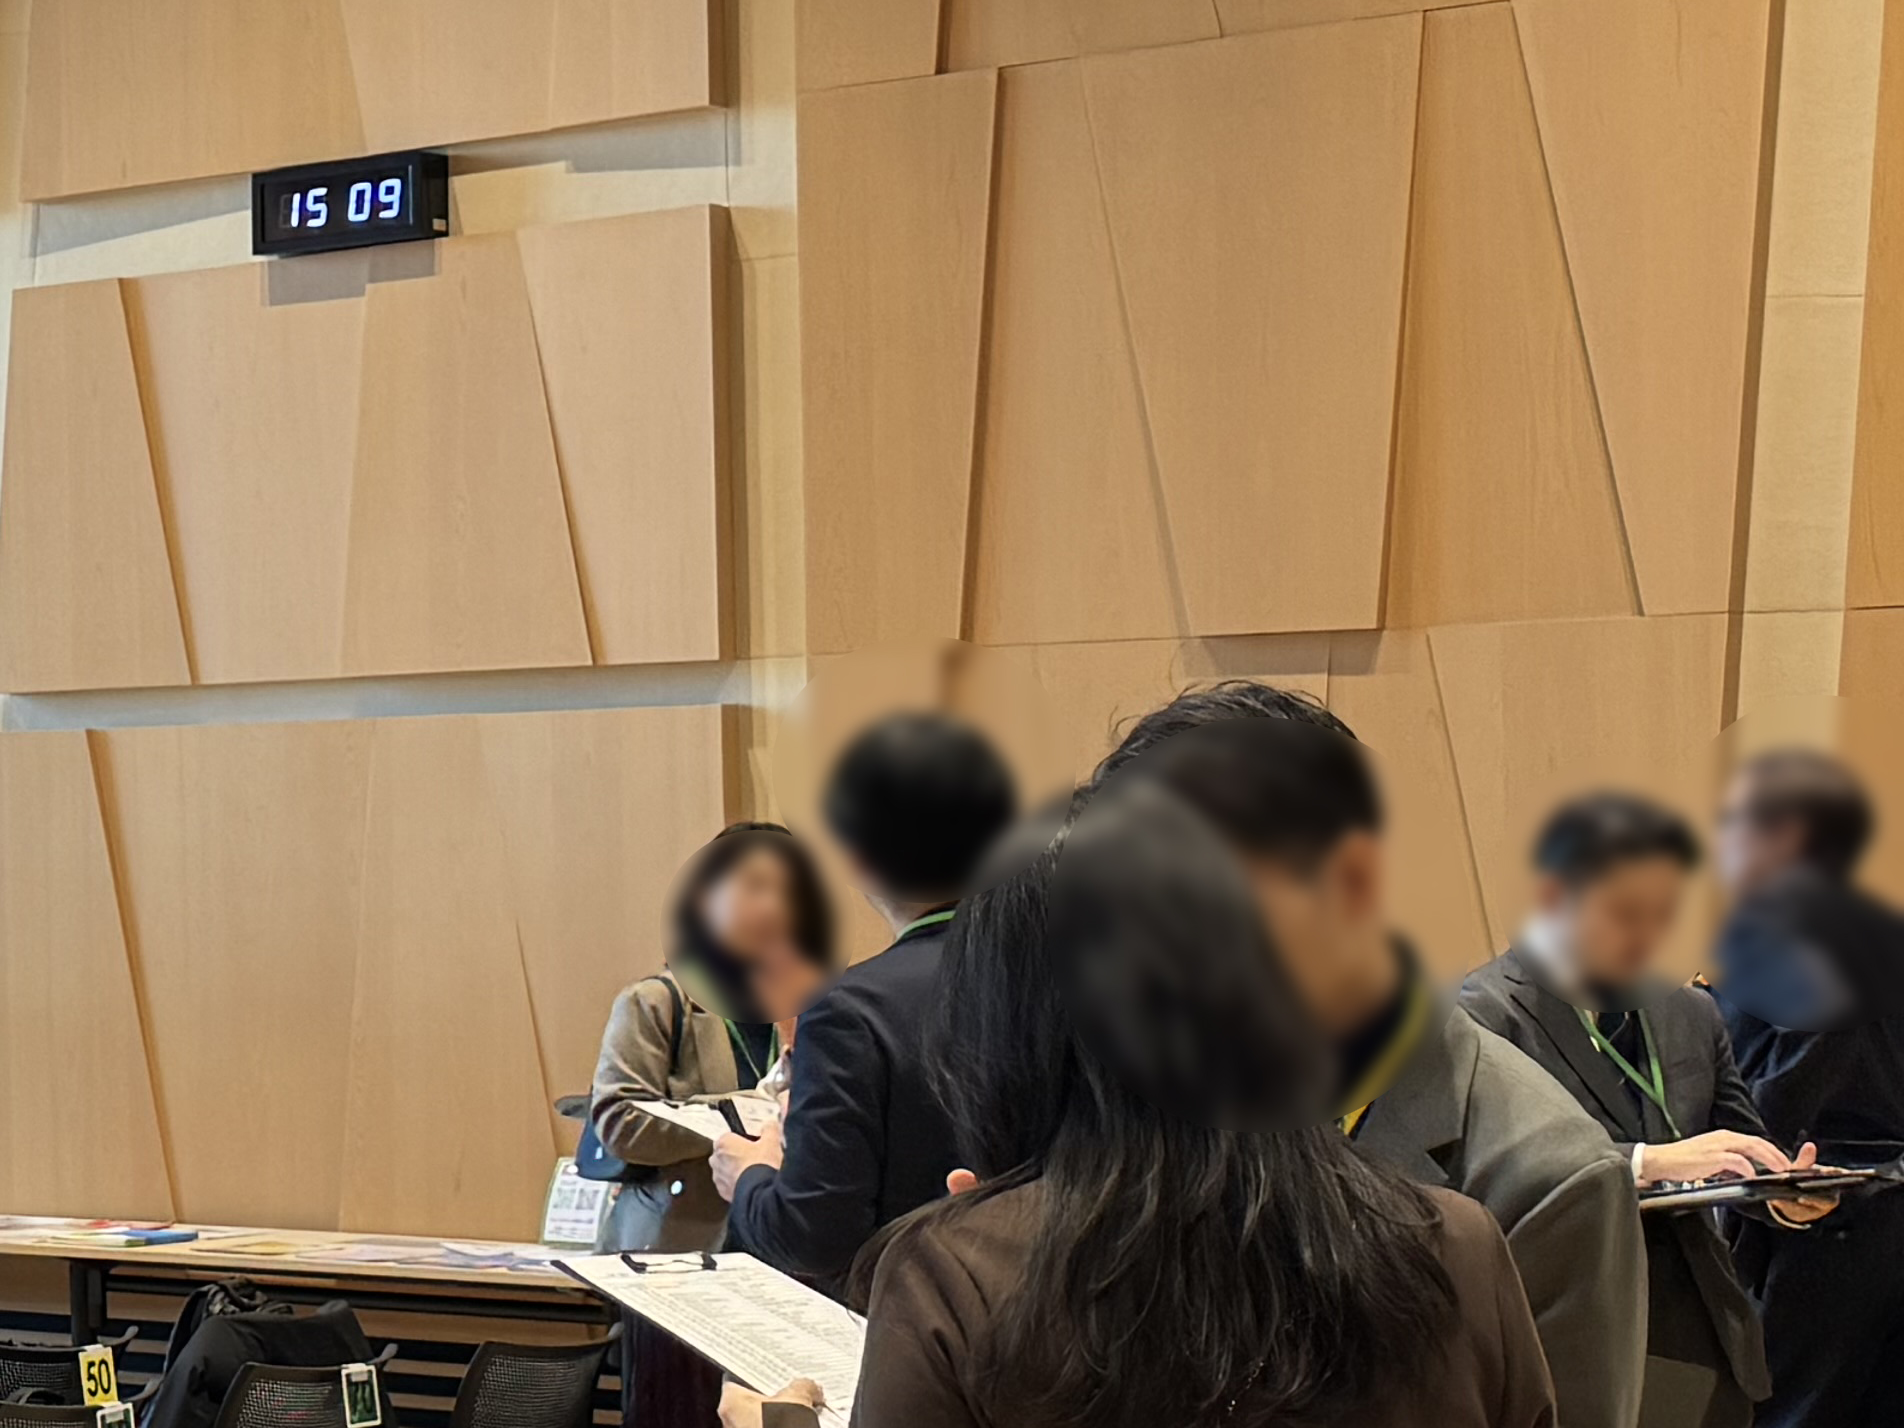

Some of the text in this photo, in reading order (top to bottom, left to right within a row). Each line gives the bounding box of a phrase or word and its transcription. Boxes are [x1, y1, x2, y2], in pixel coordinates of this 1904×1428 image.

[291, 177, 402, 228] 15 09
[86, 1358, 112, 1397] 50
